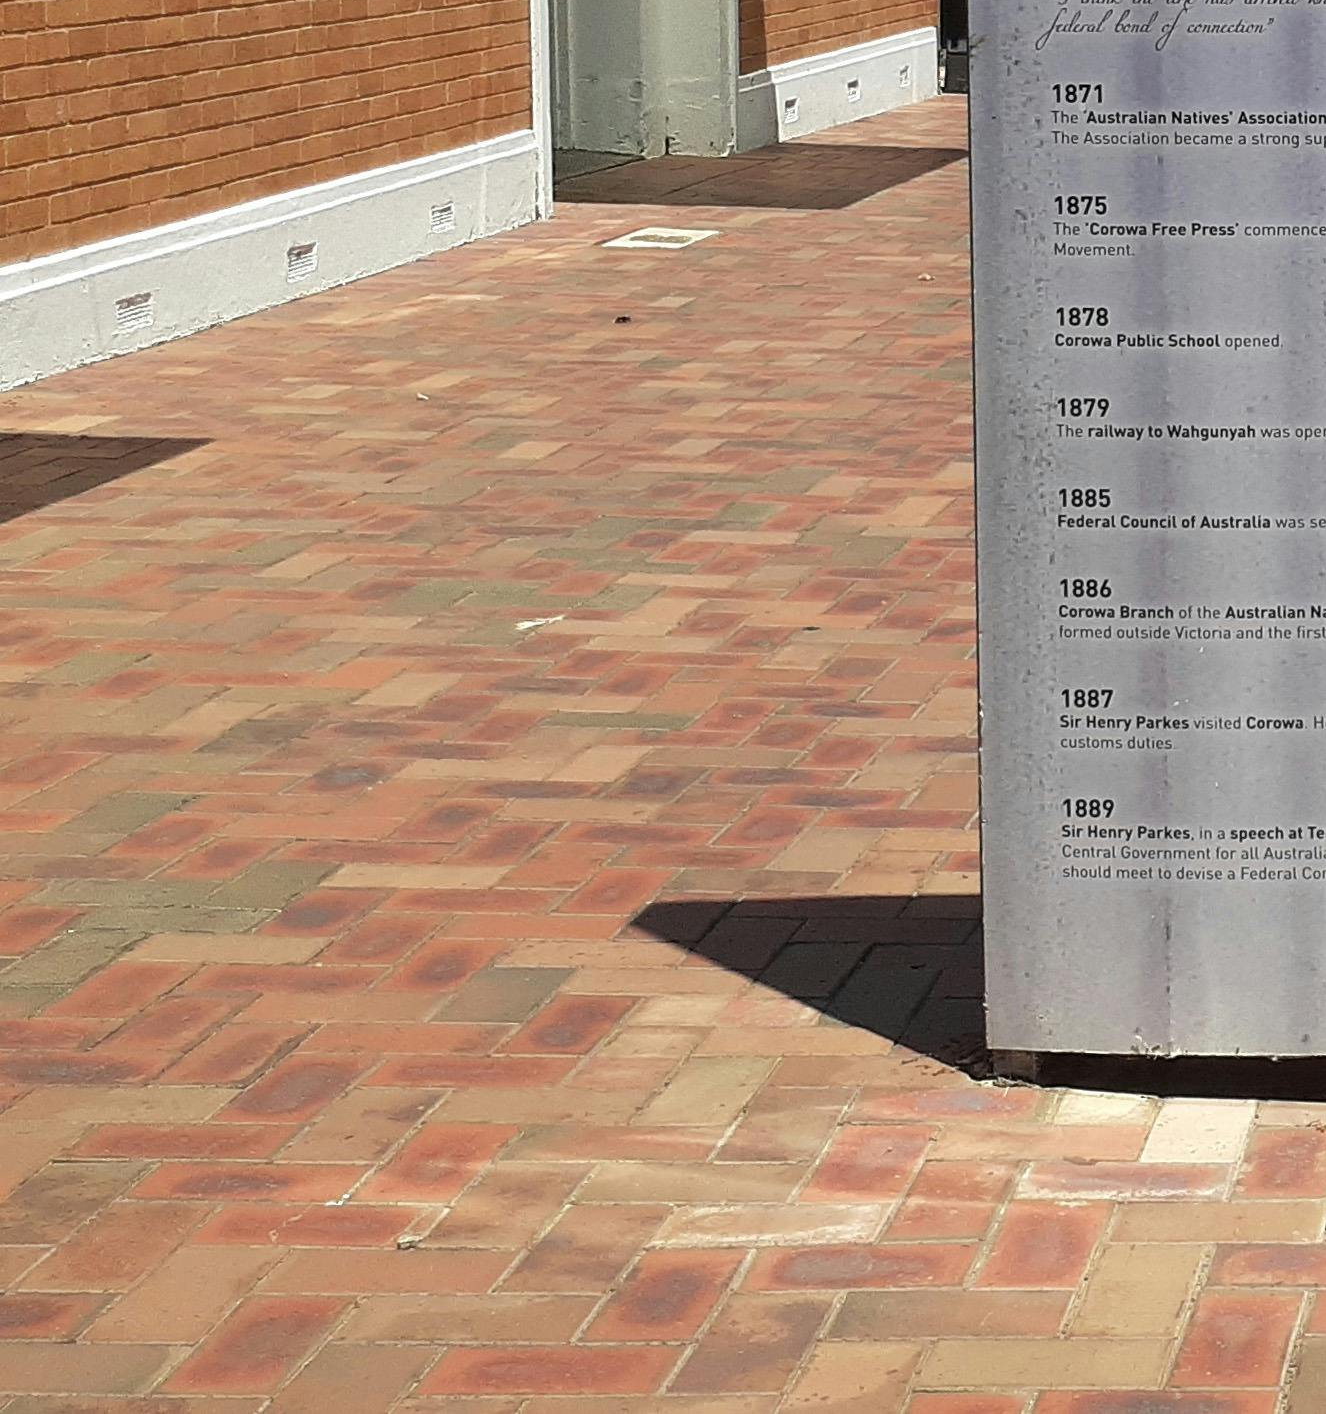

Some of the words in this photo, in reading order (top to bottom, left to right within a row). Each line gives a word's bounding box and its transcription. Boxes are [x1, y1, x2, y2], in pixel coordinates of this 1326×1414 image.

[1034, 7, 1108, 52] federal
[1113, 9, 1158, 34] bond
[1154, 6, 1185, 52] of
[1052, 83, 1103, 103] 1871
[1054, 194, 1108, 215] 1875
[1056, 306, 1109, 326] 1878
[1054, 333, 1112, 347] Corowa
[1116, 333, 1164, 353] Public
[1168, 333, 1221, 347] School
[1224, 333, 1284, 351] opened.
[1053, 397, 1110, 418] 1879
[1058, 487, 1111, 508] 1885
[1059, 578, 1112, 598] 1886
[1061, 688, 1114, 708] 1887
[1062, 798, 1115, 818] 1889
